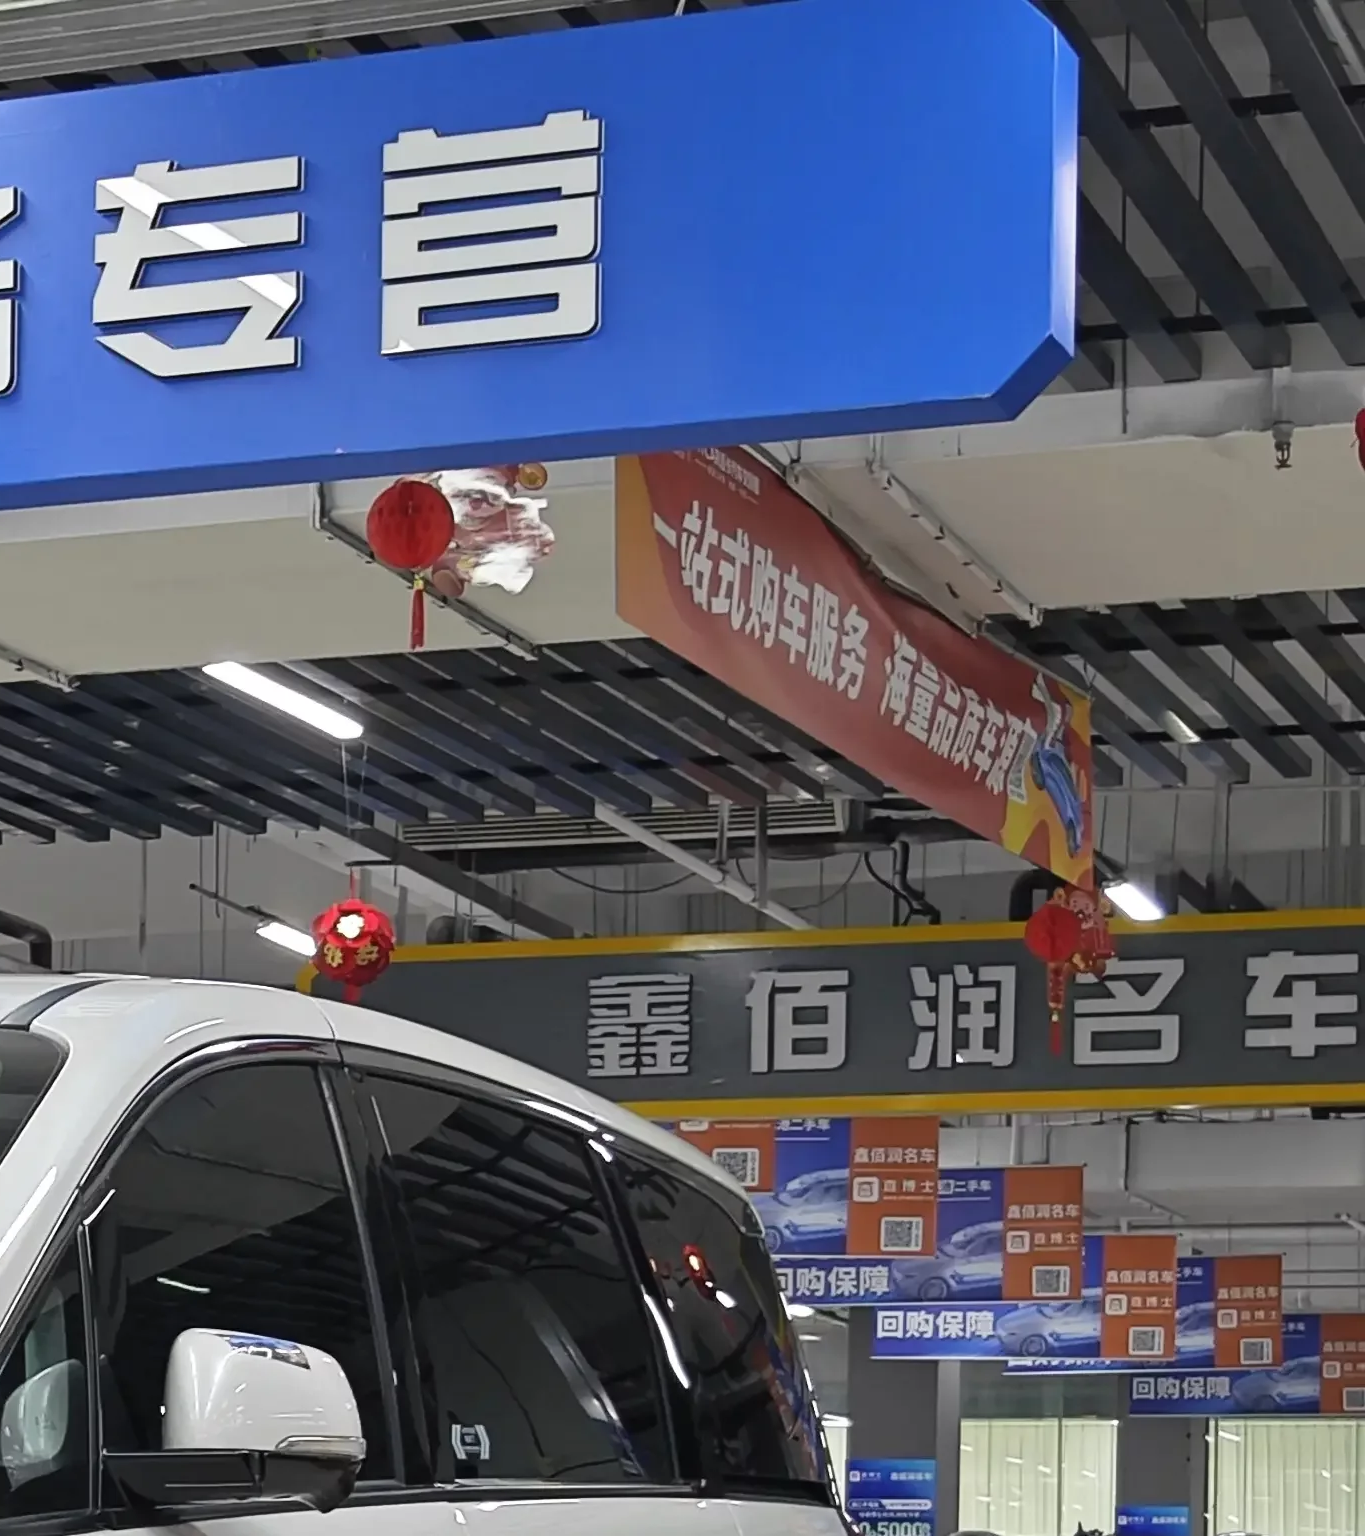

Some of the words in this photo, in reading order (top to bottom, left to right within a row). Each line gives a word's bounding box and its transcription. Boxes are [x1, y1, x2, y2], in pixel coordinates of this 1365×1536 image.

[653, 500, 869, 700] 一站式购车服务
[587, 950, 1360, 1077] 鑫佰润名车
[876, 1310, 995, 1339] 回购保障
[1132, 1376, 1232, 1400] 回购保障
